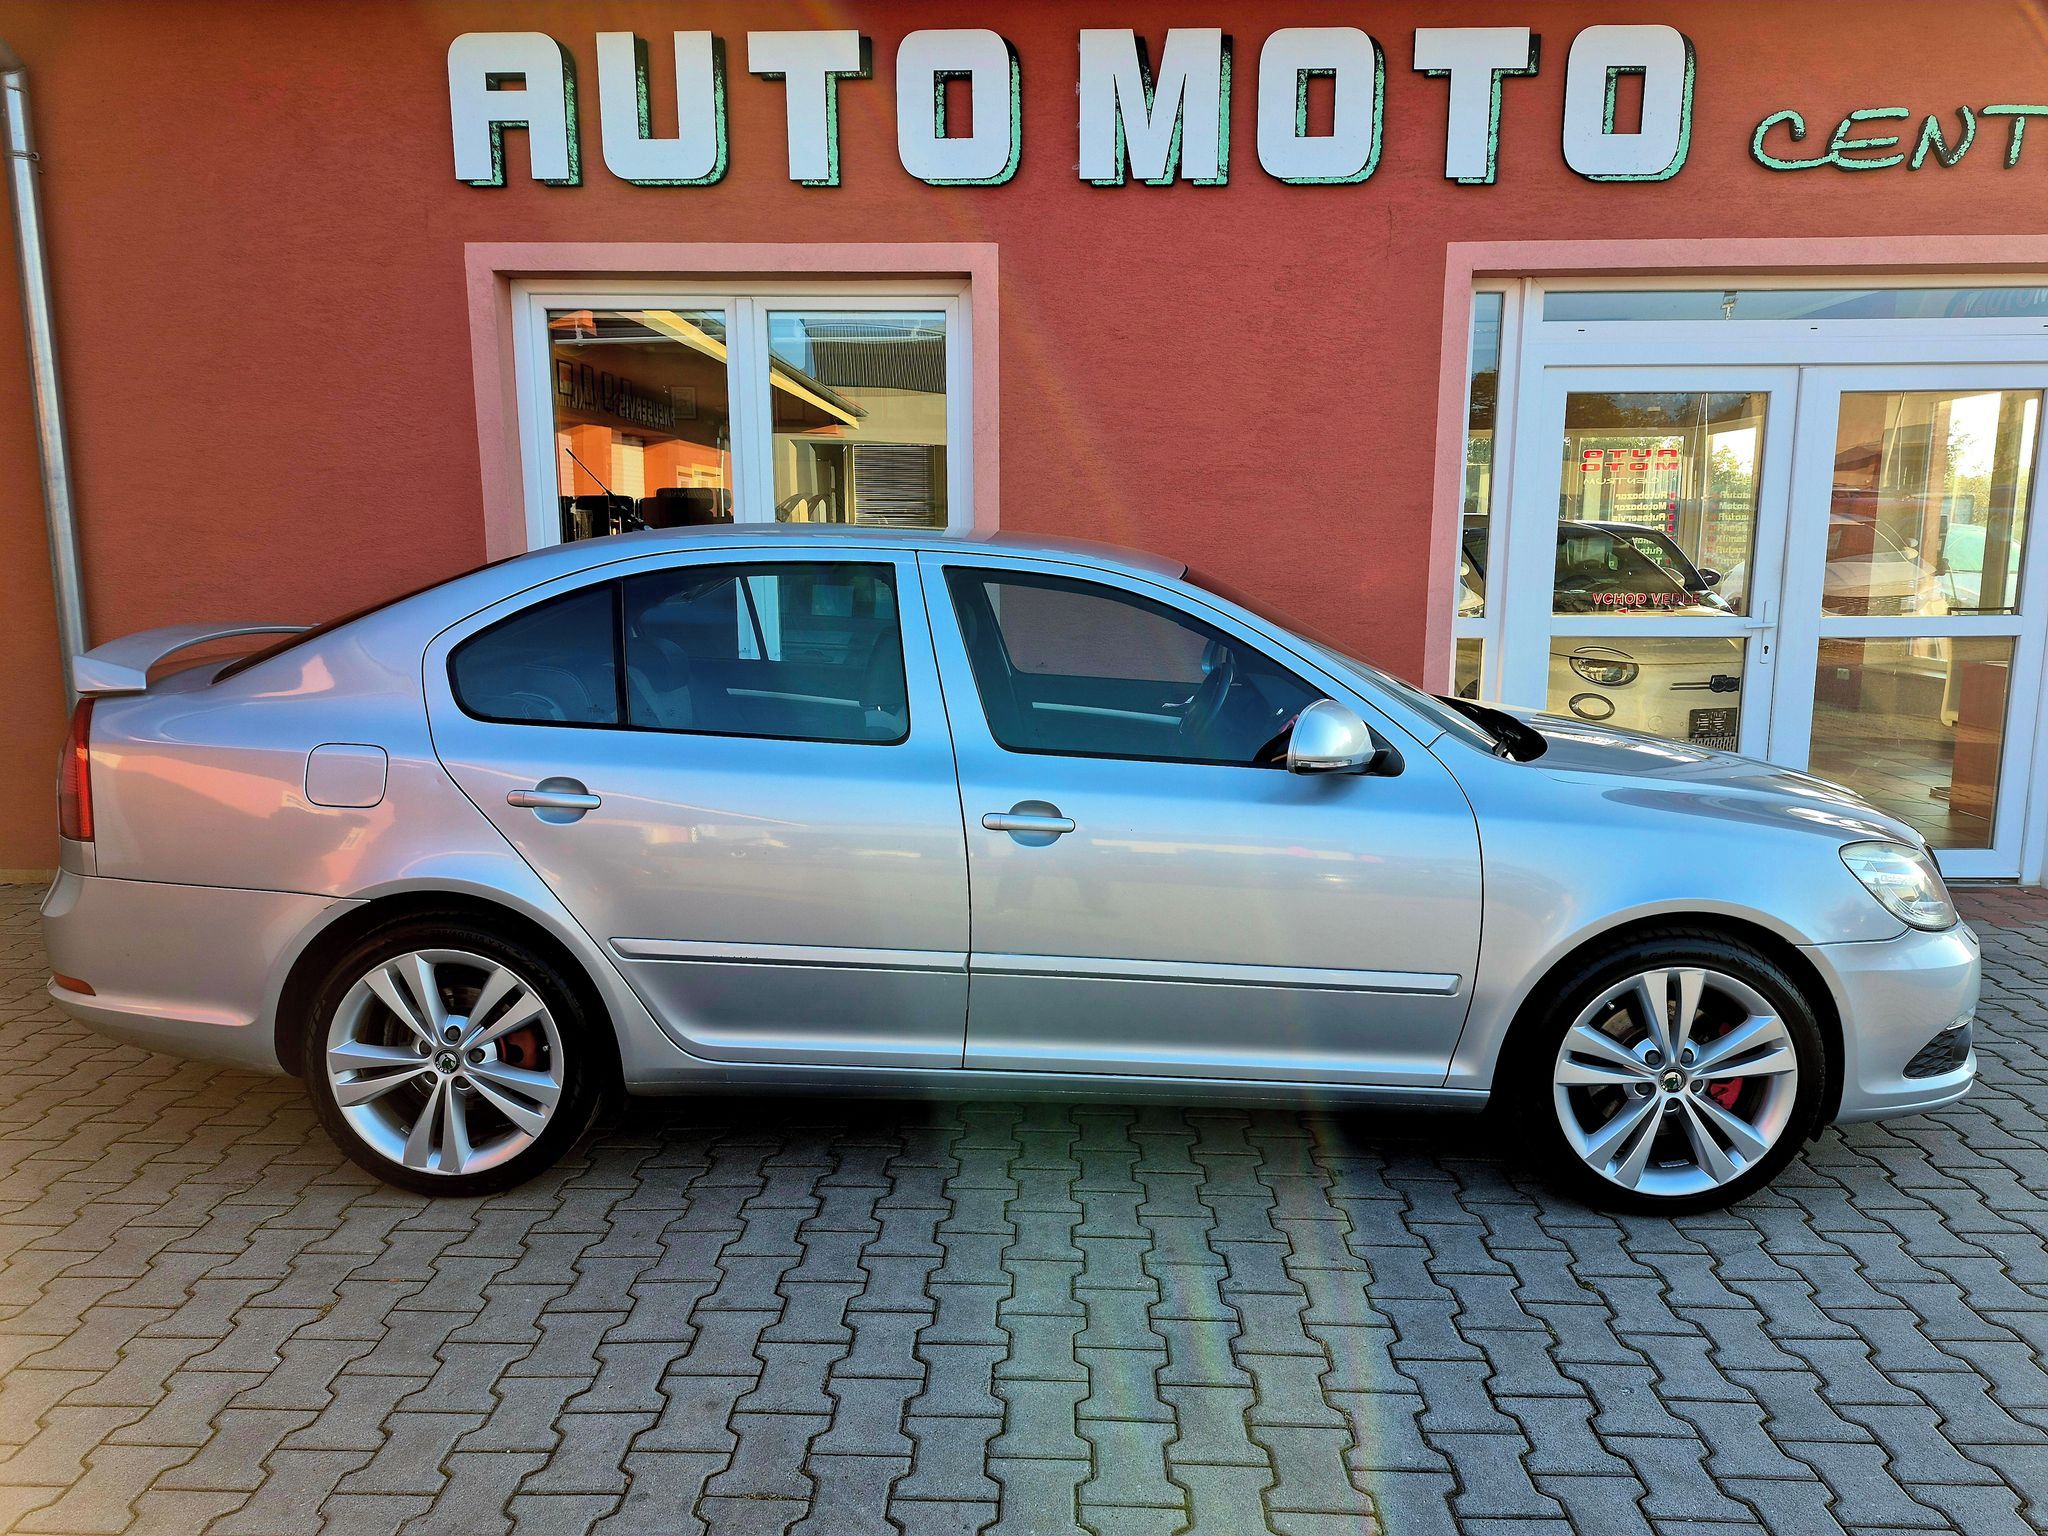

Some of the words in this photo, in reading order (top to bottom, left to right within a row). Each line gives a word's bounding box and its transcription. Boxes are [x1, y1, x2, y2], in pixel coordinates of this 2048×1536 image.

[447, 29, 1022, 188] AUTO
[1077, 24, 1695, 187] MOTO
[1749, 104, 2048, 172] CENT
[1592, 592, 1647, 605] VCHOD
[1650, 592, 1700, 605] VEDLE
